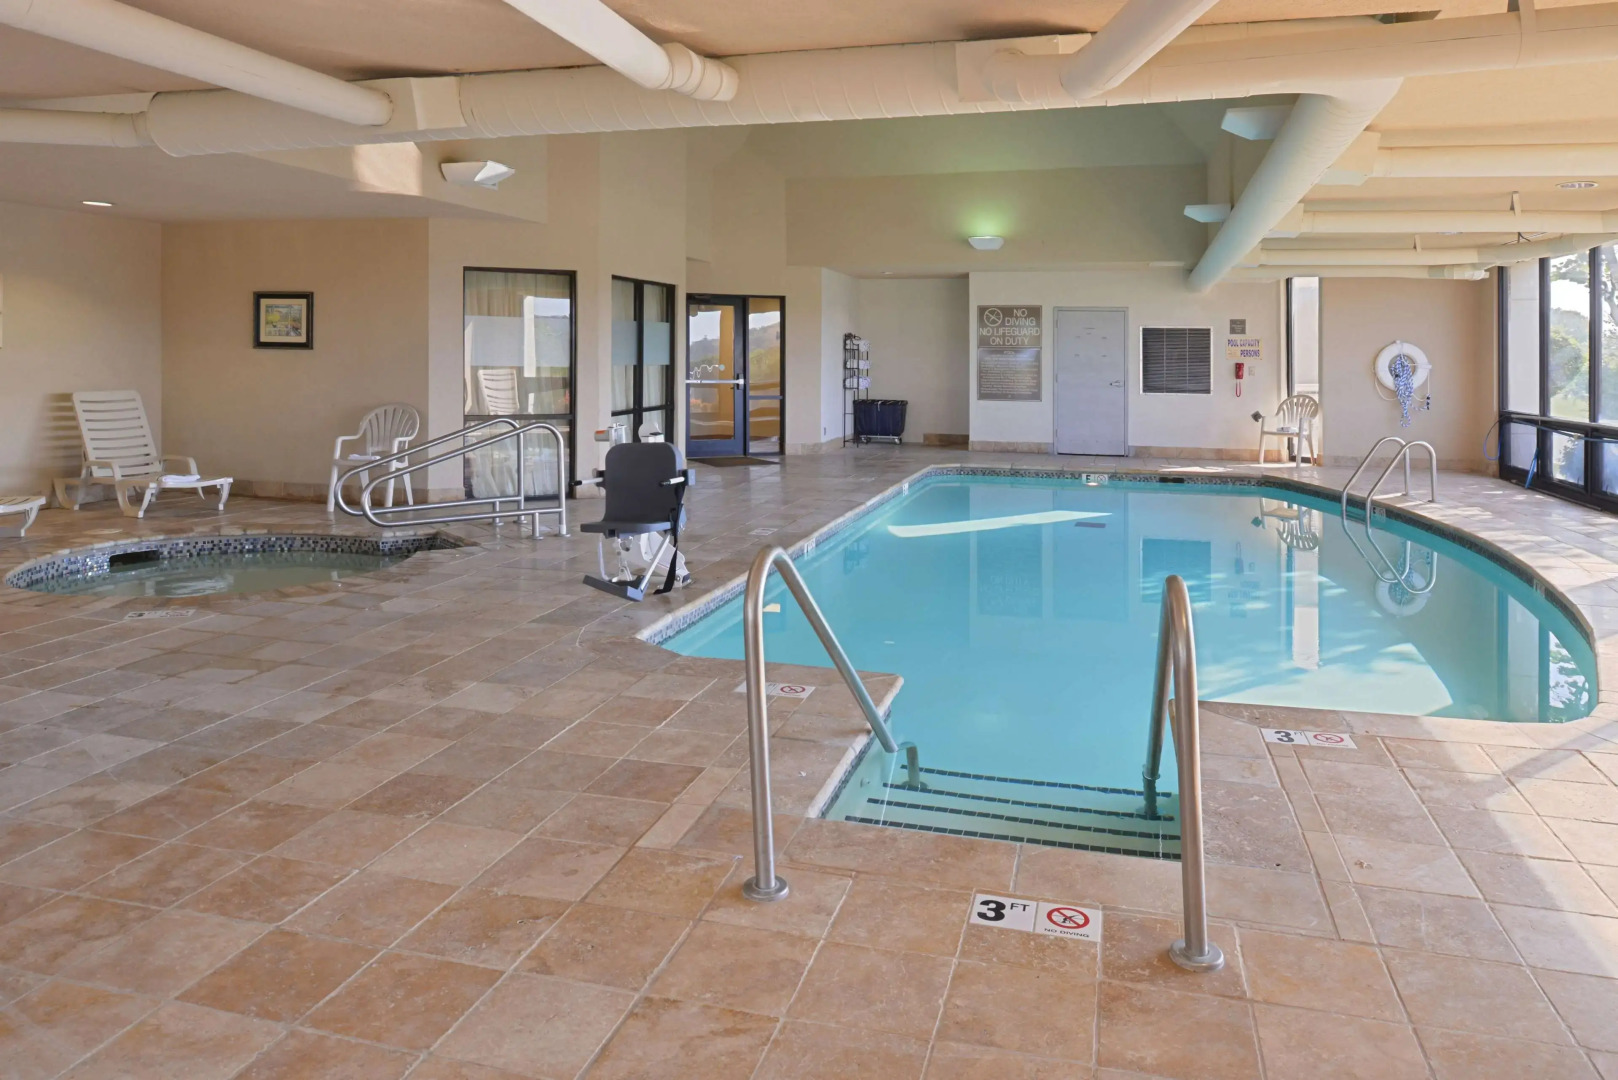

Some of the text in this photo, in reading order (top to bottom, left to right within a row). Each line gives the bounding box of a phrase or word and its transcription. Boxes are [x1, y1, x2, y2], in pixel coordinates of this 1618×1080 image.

[1013, 308, 1028, 317] NO
[1004, 317, 1036, 326] DIVING
[979, 327, 1040, 336] NO LIFEGUARD
[990, 337, 1029, 346] ON DUTY
[1227, 339, 1260, 347] POOL CAPACITY
[1240, 349, 1260, 358] PERSONS
[1274, 730, 1295, 743] 3
[977, 899, 1030, 922] 3 FT
[1060, 929, 1090, 938] DIVING
